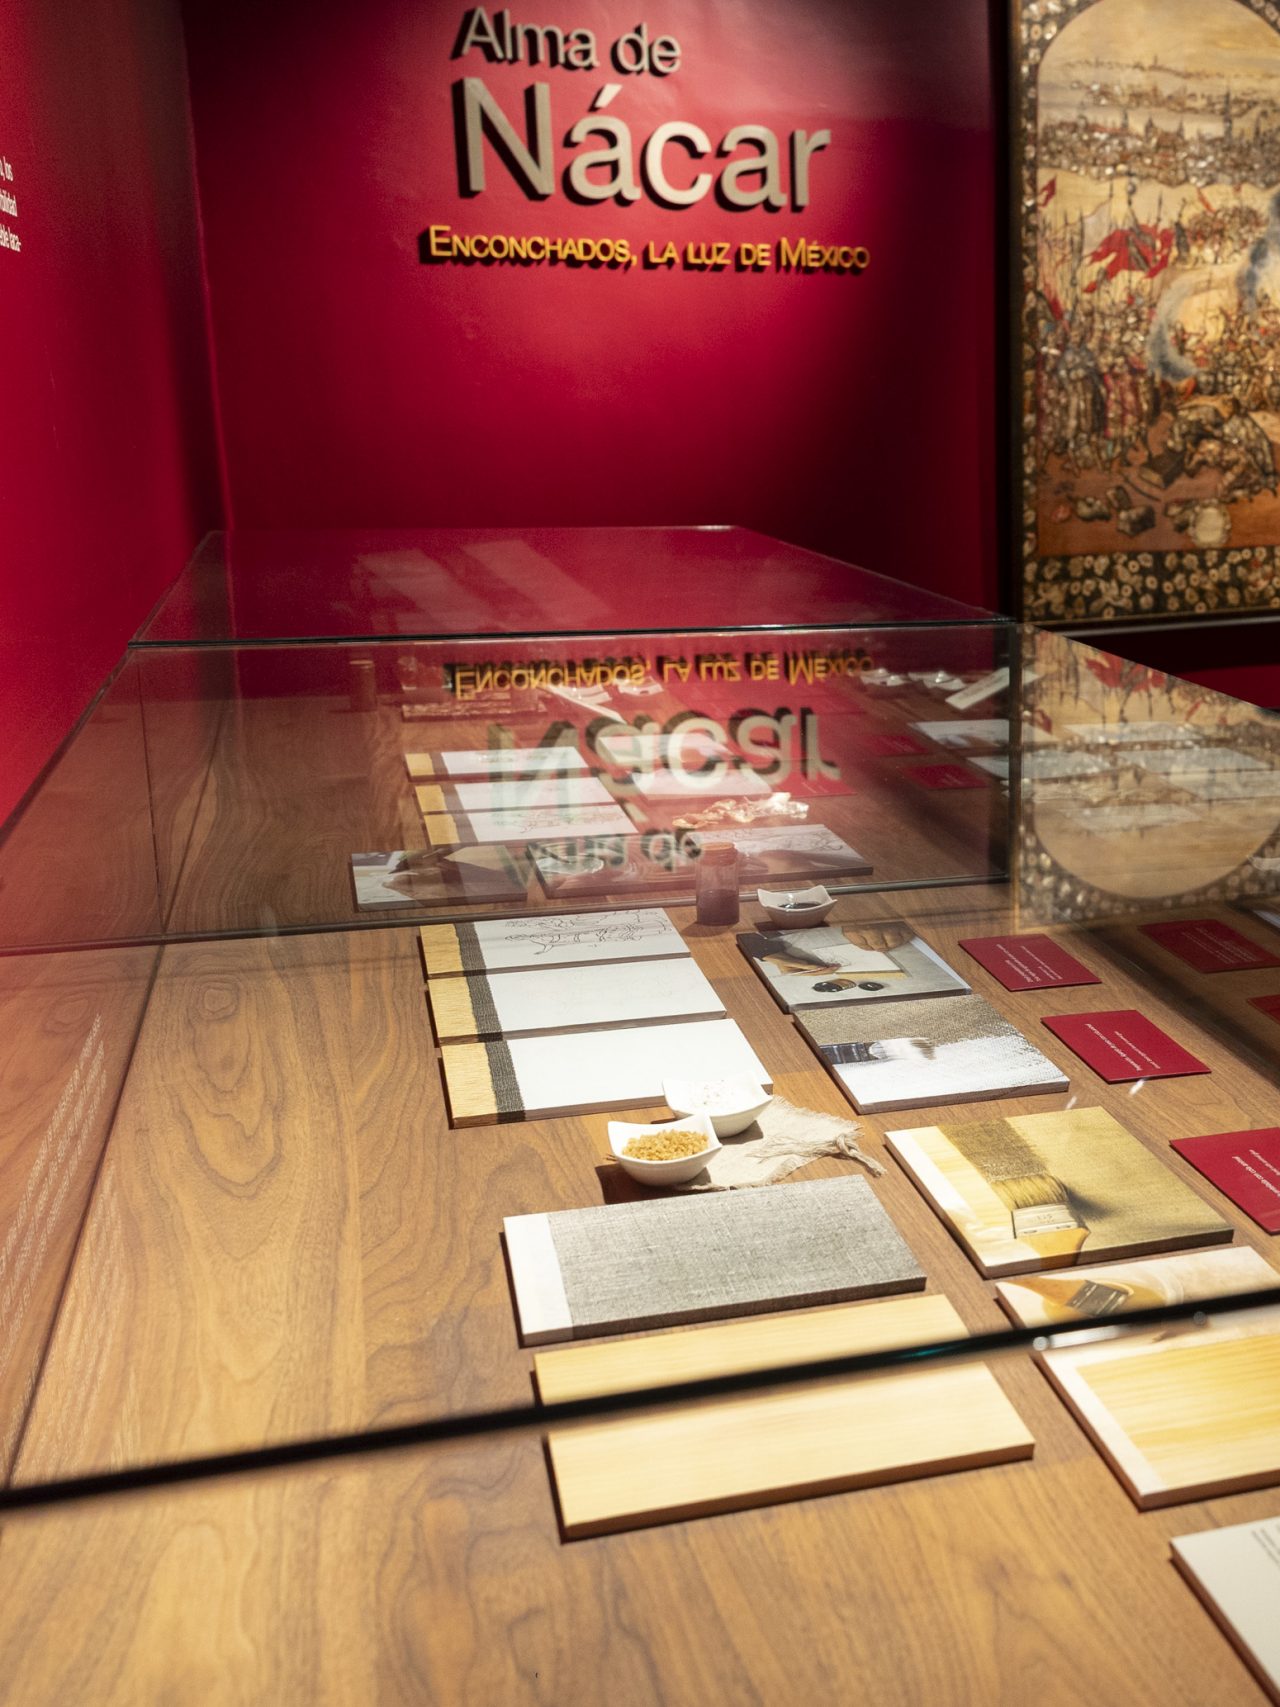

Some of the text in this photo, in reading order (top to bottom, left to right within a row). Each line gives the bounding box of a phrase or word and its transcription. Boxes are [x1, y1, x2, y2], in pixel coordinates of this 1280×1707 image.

[460, 7, 682, 75] Alma de
[462, 76, 832, 208] Nácar
[649, 240, 680, 265] LA
[687, 241, 732, 267] LUZ
[740, 242, 772, 268] DE
